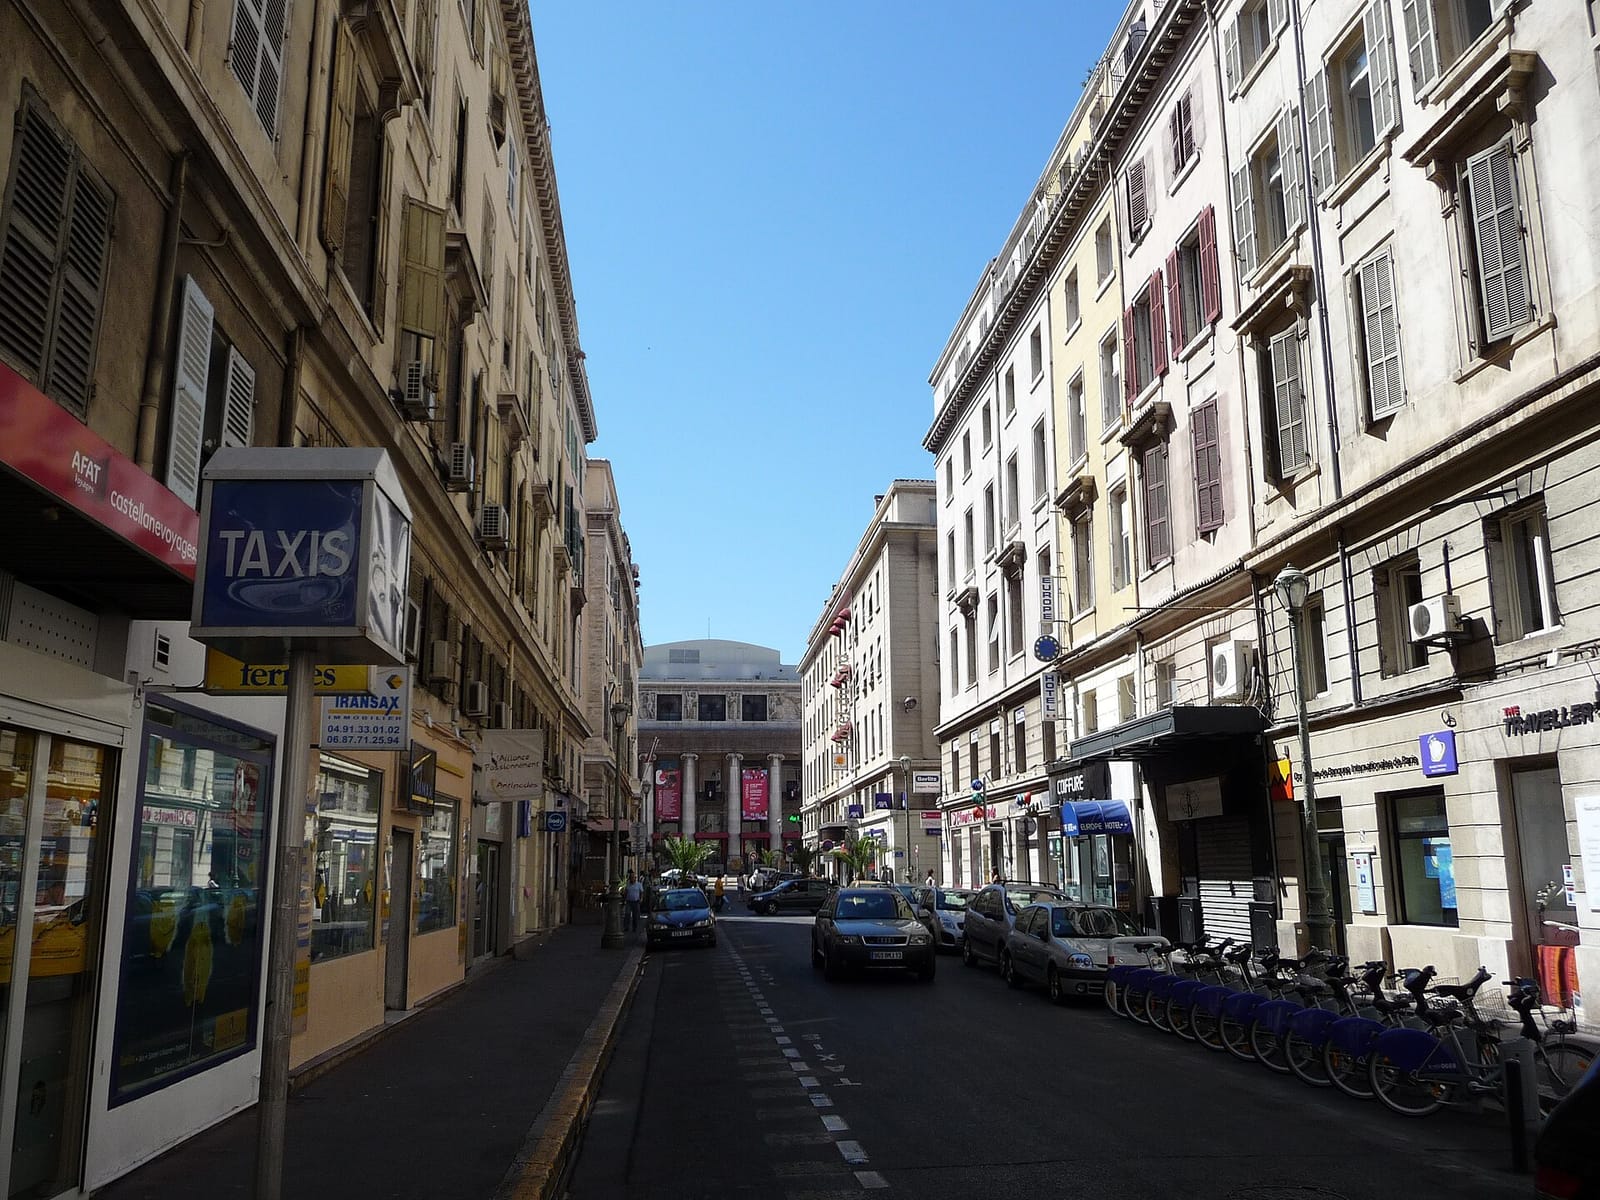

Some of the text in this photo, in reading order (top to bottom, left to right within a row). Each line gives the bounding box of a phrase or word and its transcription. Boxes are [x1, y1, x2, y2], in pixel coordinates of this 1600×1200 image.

[71, 450, 102, 485] AFAT
[218, 529, 351, 577] TAXIS
[1041, 576, 1053, 620] EUROPE
[1044, 674, 1056, 713] HOTEL
[327, 725, 400, 734] 04.91.33.01.02
[327, 735, 400, 745] 06.87.71.25.94
[1057, 774, 1084, 795] COIFFURE
[1080, 822, 1103, 831] EUROPE
[1104, 820, 1122, 830] HOTEL
